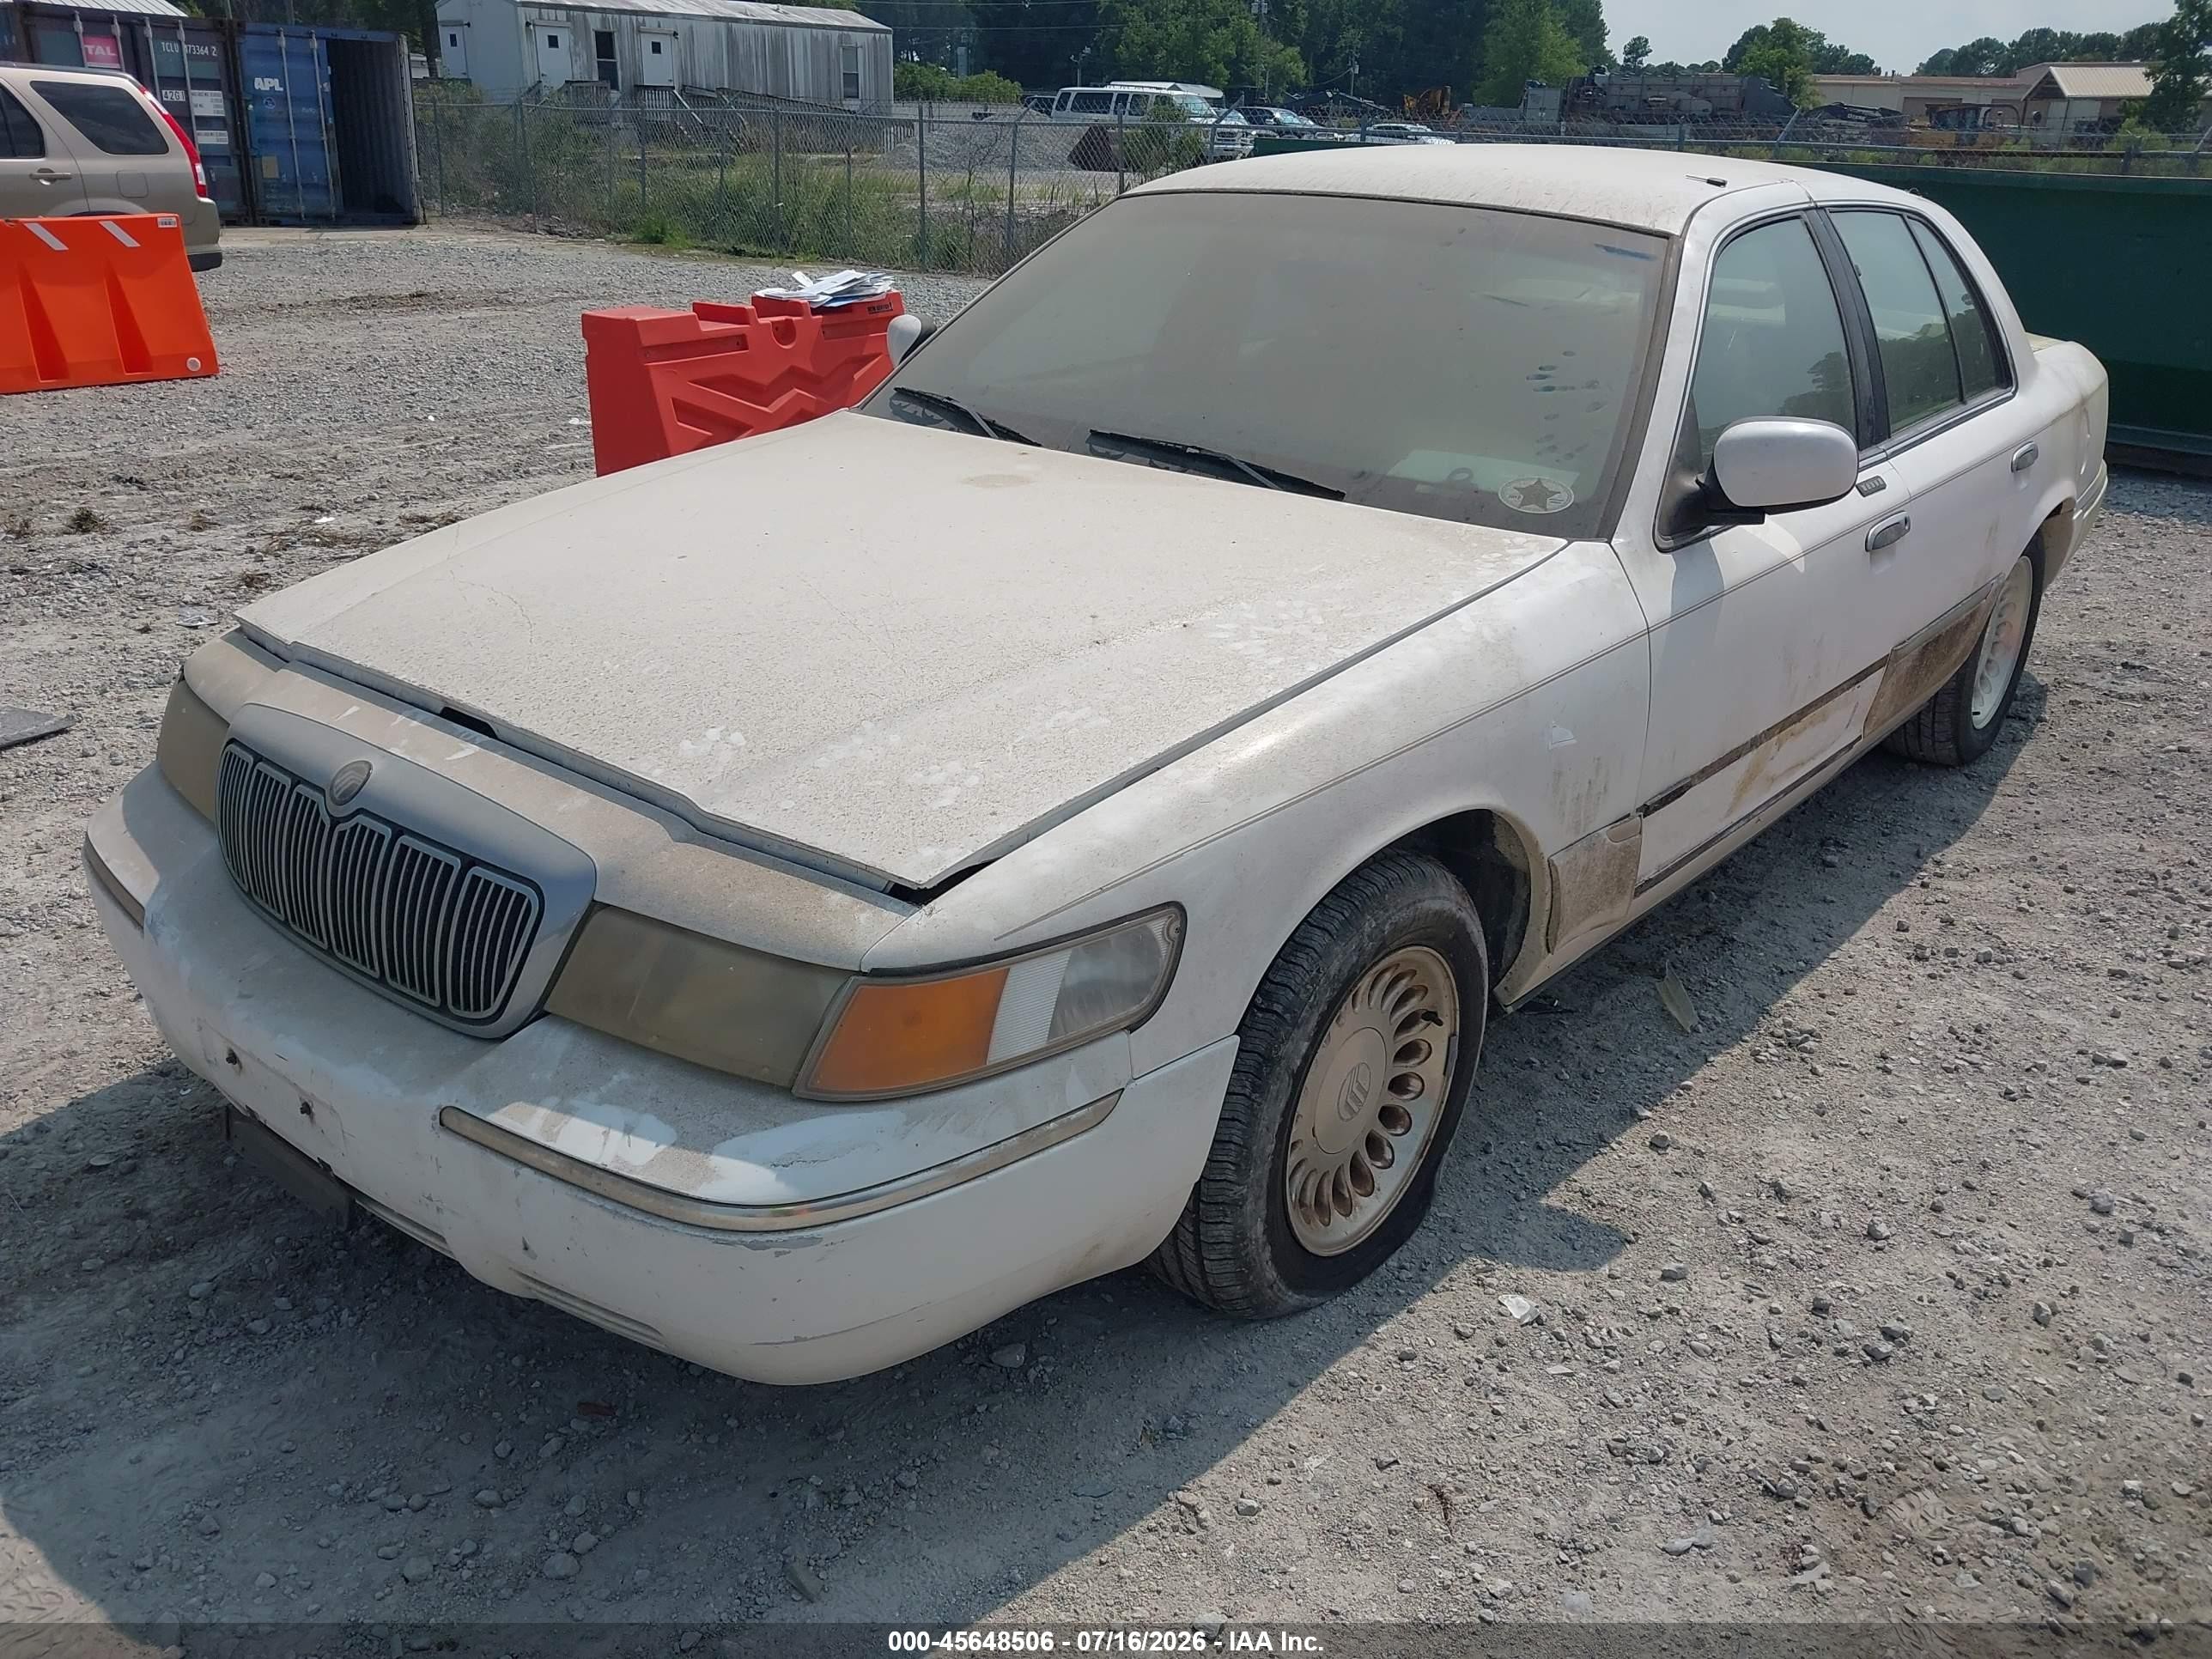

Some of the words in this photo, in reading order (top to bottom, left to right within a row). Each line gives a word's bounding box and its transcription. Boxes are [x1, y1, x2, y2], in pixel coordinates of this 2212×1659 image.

[83, 45, 118, 56] TAL
[161, 41, 179, 53] TCLU
[211, 46, 218, 57] 2
[253, 77, 284, 91] APL
[163, 90, 185, 100] 42G1
